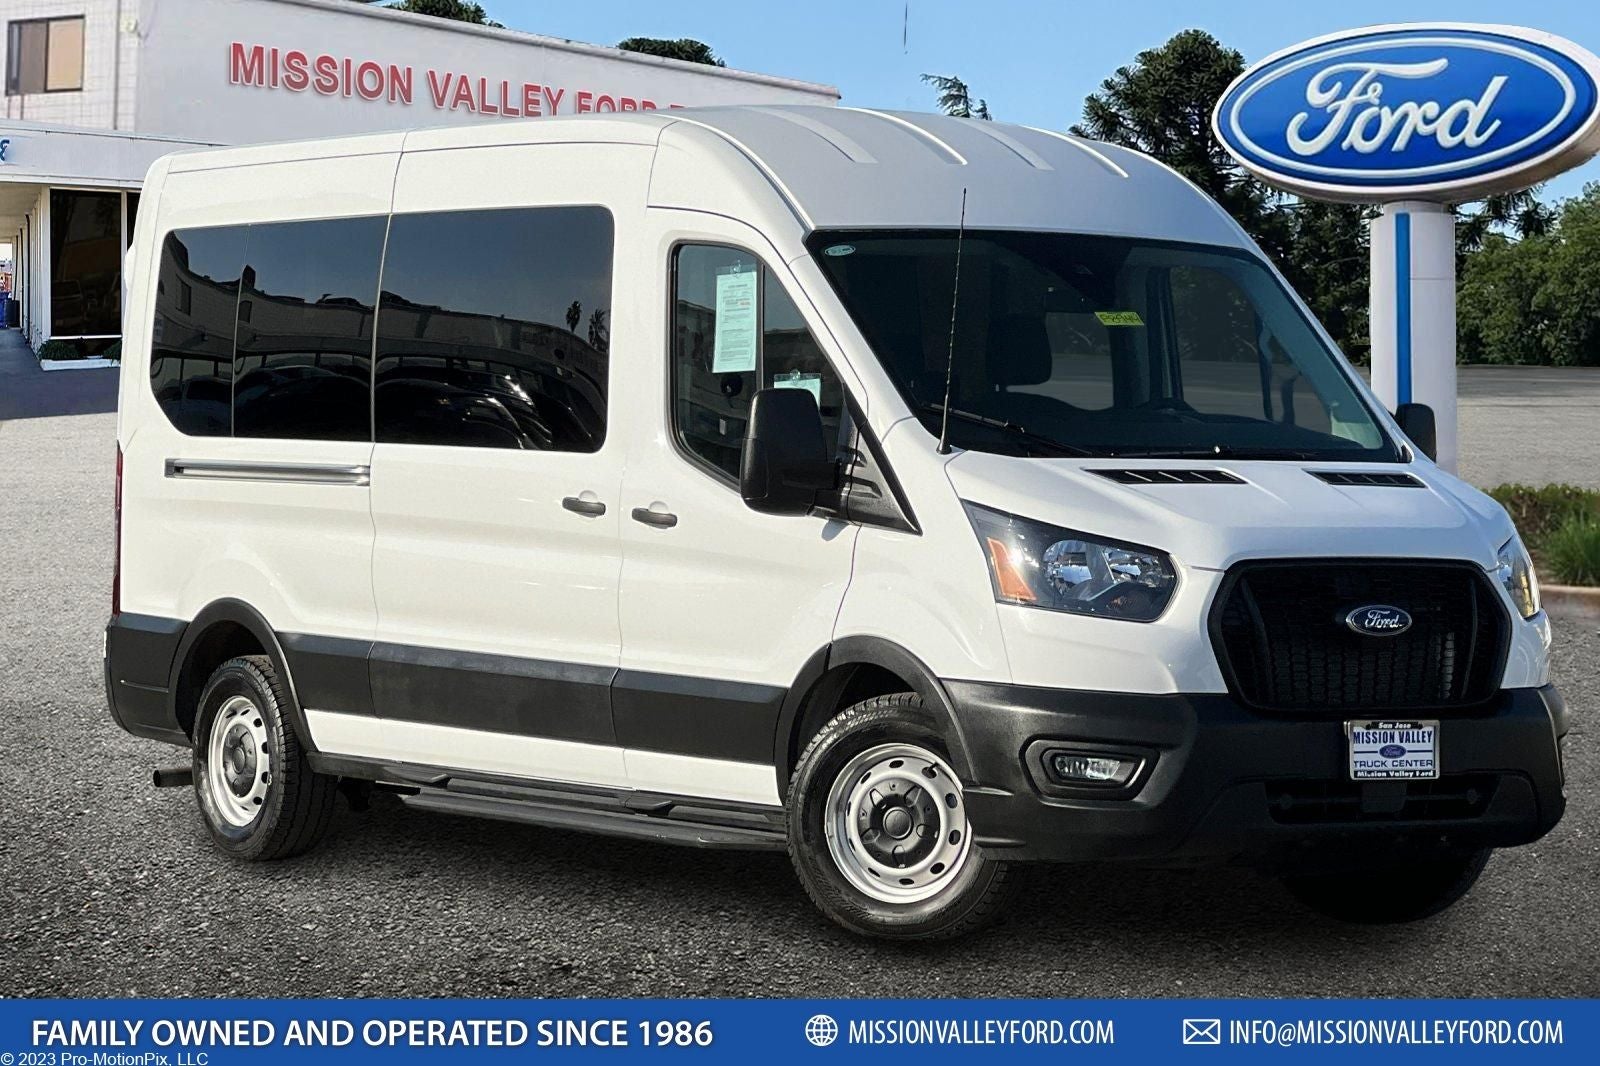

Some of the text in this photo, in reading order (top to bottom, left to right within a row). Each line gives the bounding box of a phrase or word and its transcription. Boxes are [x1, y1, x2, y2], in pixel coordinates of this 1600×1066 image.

[230, 41, 413, 105] MISSION
[427, 69, 565, 118] VALLEY
[1286, 57, 1509, 156] Ford
[1364, 609, 1400, 629] Ford
[1353, 730, 1433, 745] MISSION VALLEY
[1353, 760, 1433, 768] TRUCK CENTER
